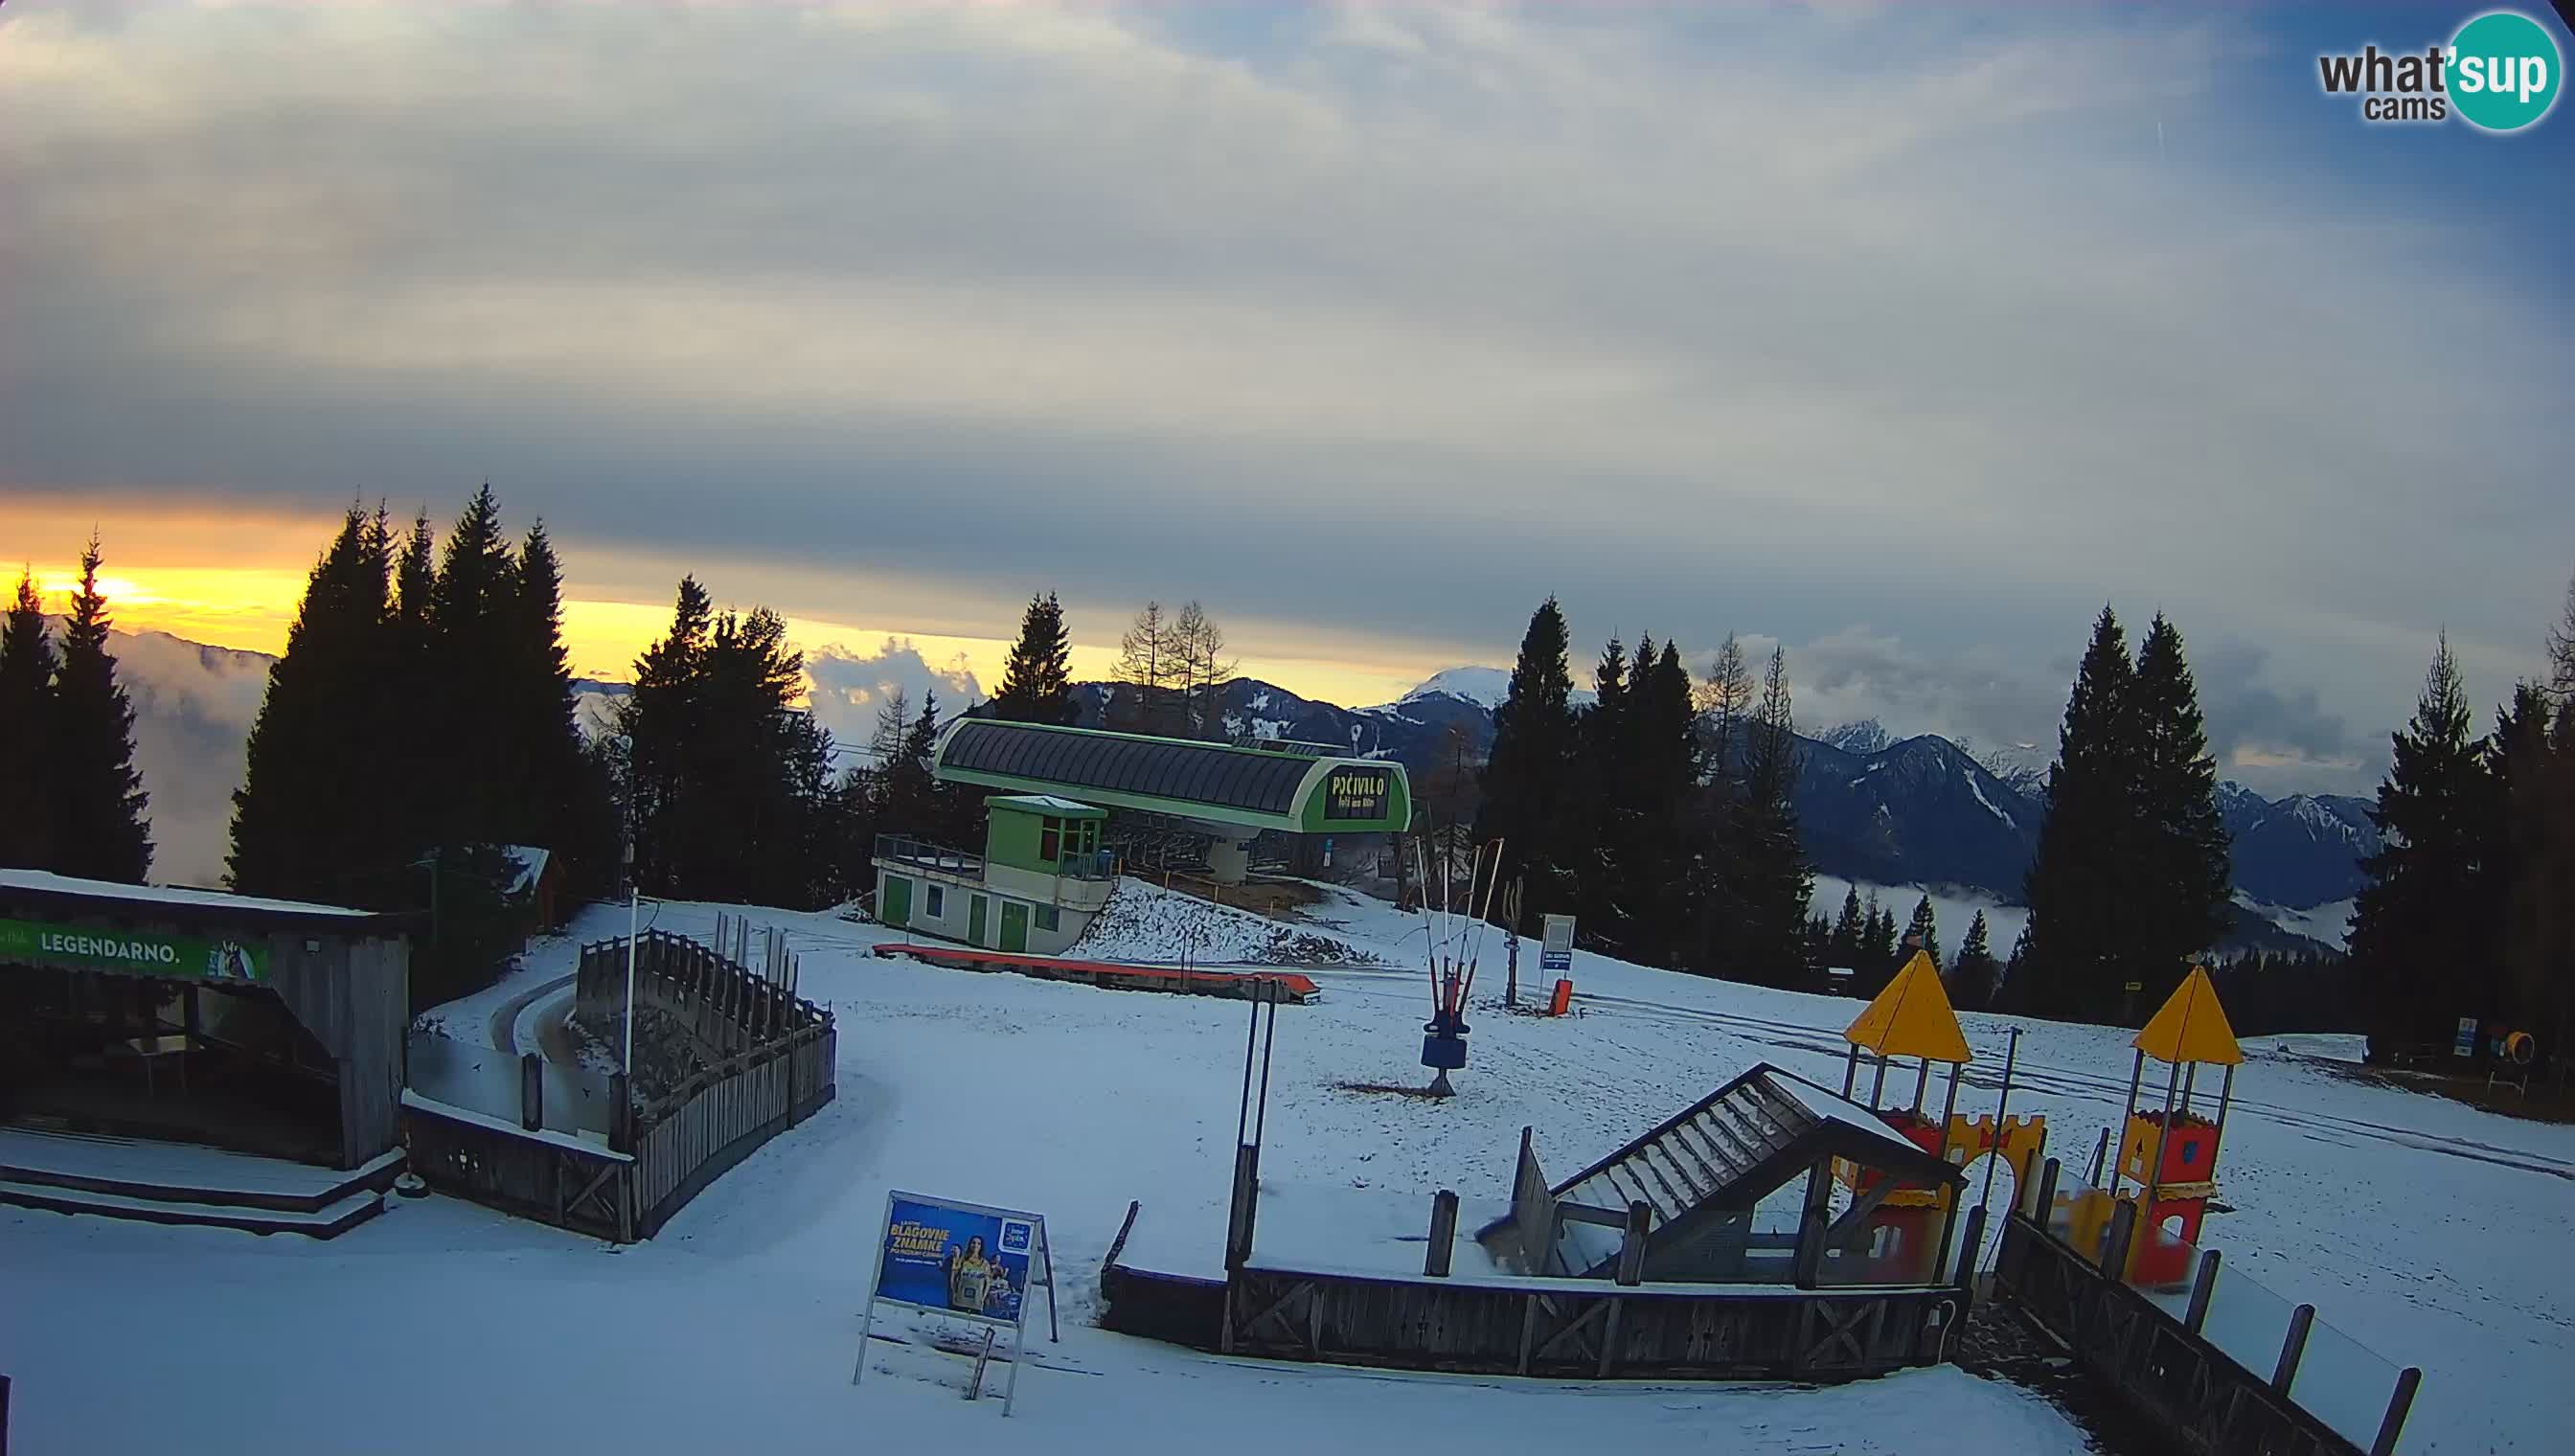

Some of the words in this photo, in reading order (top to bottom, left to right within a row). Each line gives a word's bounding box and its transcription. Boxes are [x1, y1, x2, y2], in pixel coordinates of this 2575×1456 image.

[41, 932, 180, 964] LEGENDARNO.
[891, 1224, 950, 1240] BLAGOVNE
[893, 1237, 944, 1252] ZNAMKE
